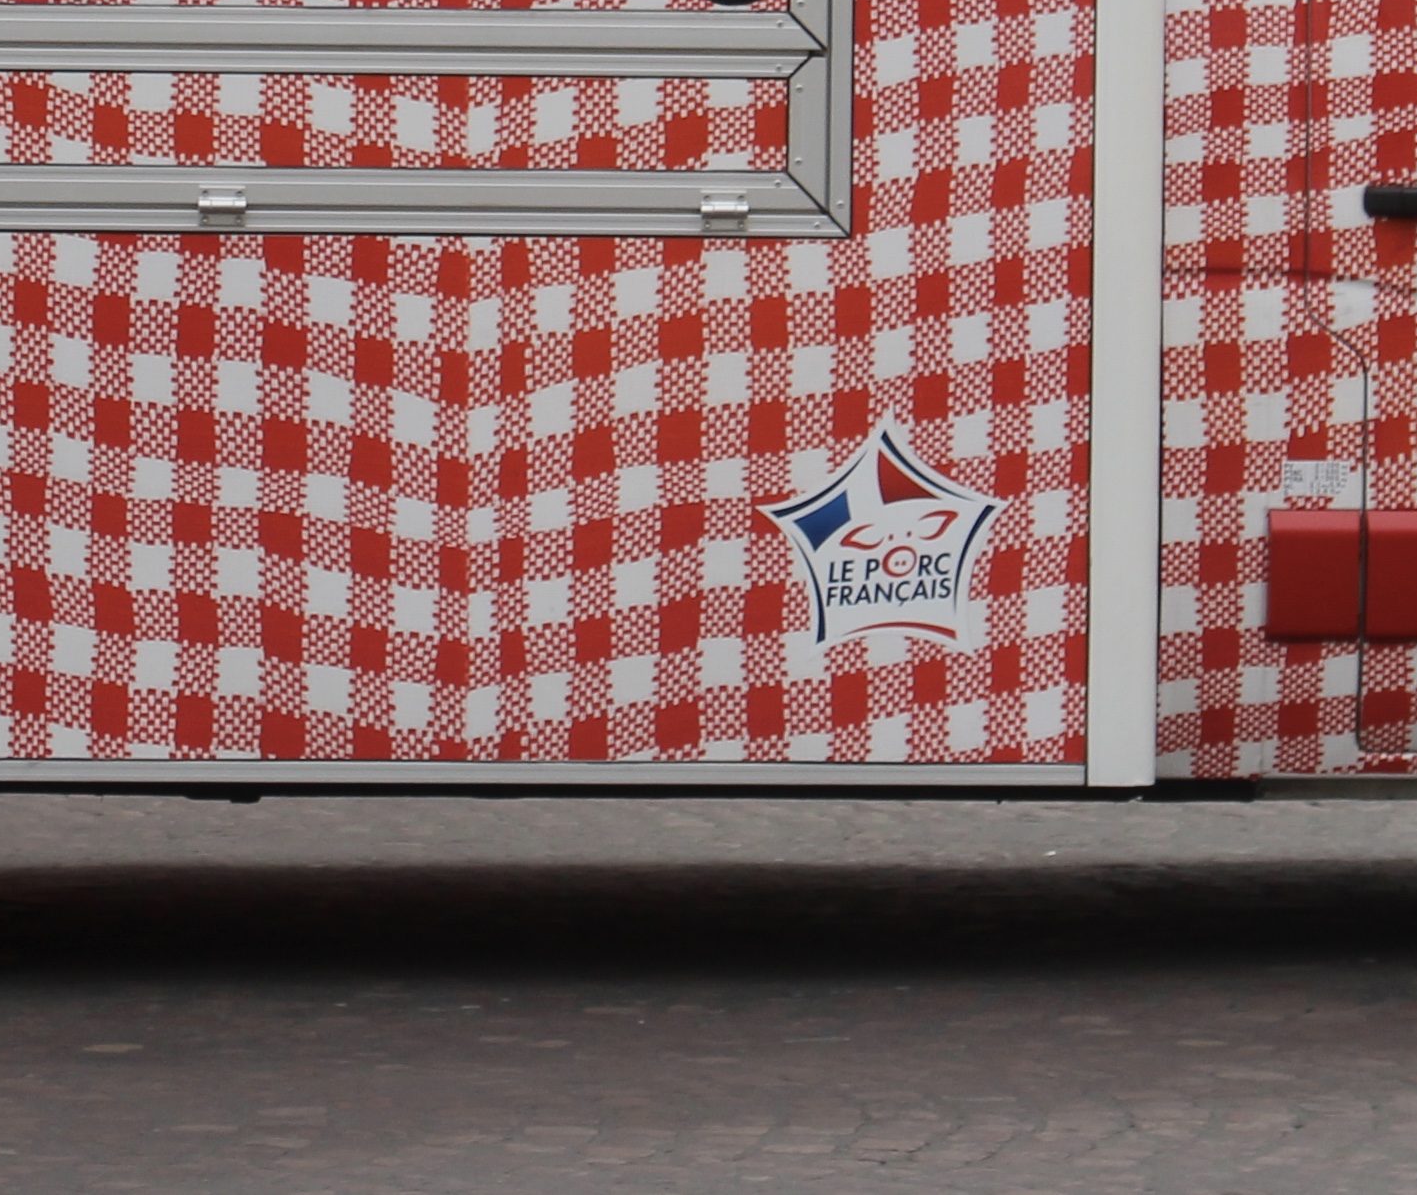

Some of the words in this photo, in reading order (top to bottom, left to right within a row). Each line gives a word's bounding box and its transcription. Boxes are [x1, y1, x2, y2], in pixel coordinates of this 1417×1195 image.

[828, 560, 854, 583] LE
[865, 545, 951, 580] PORC
[826, 578, 952, 607] FRANÇAIS
